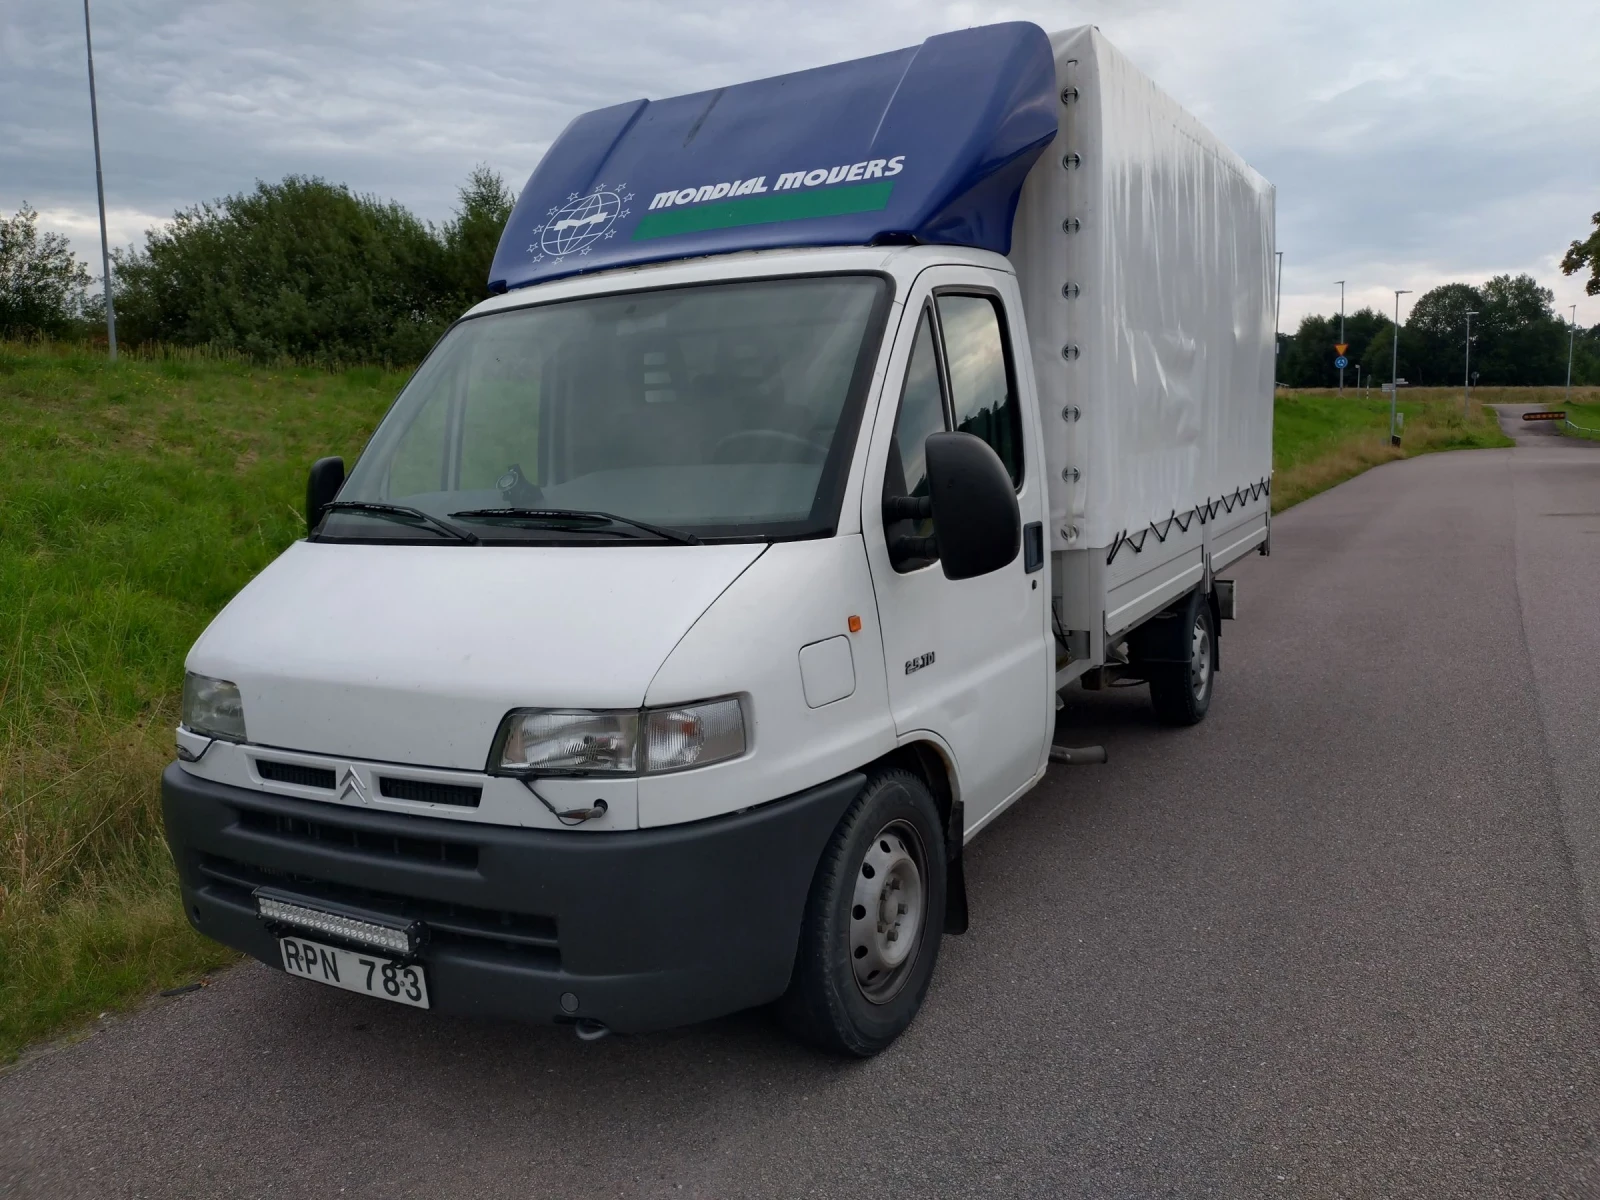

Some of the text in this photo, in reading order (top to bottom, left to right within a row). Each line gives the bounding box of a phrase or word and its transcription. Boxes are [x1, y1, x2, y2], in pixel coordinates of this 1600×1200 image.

[648, 156, 905, 210] MONDIAL MOVERS
[283, 939, 422, 1002] RPN 783
